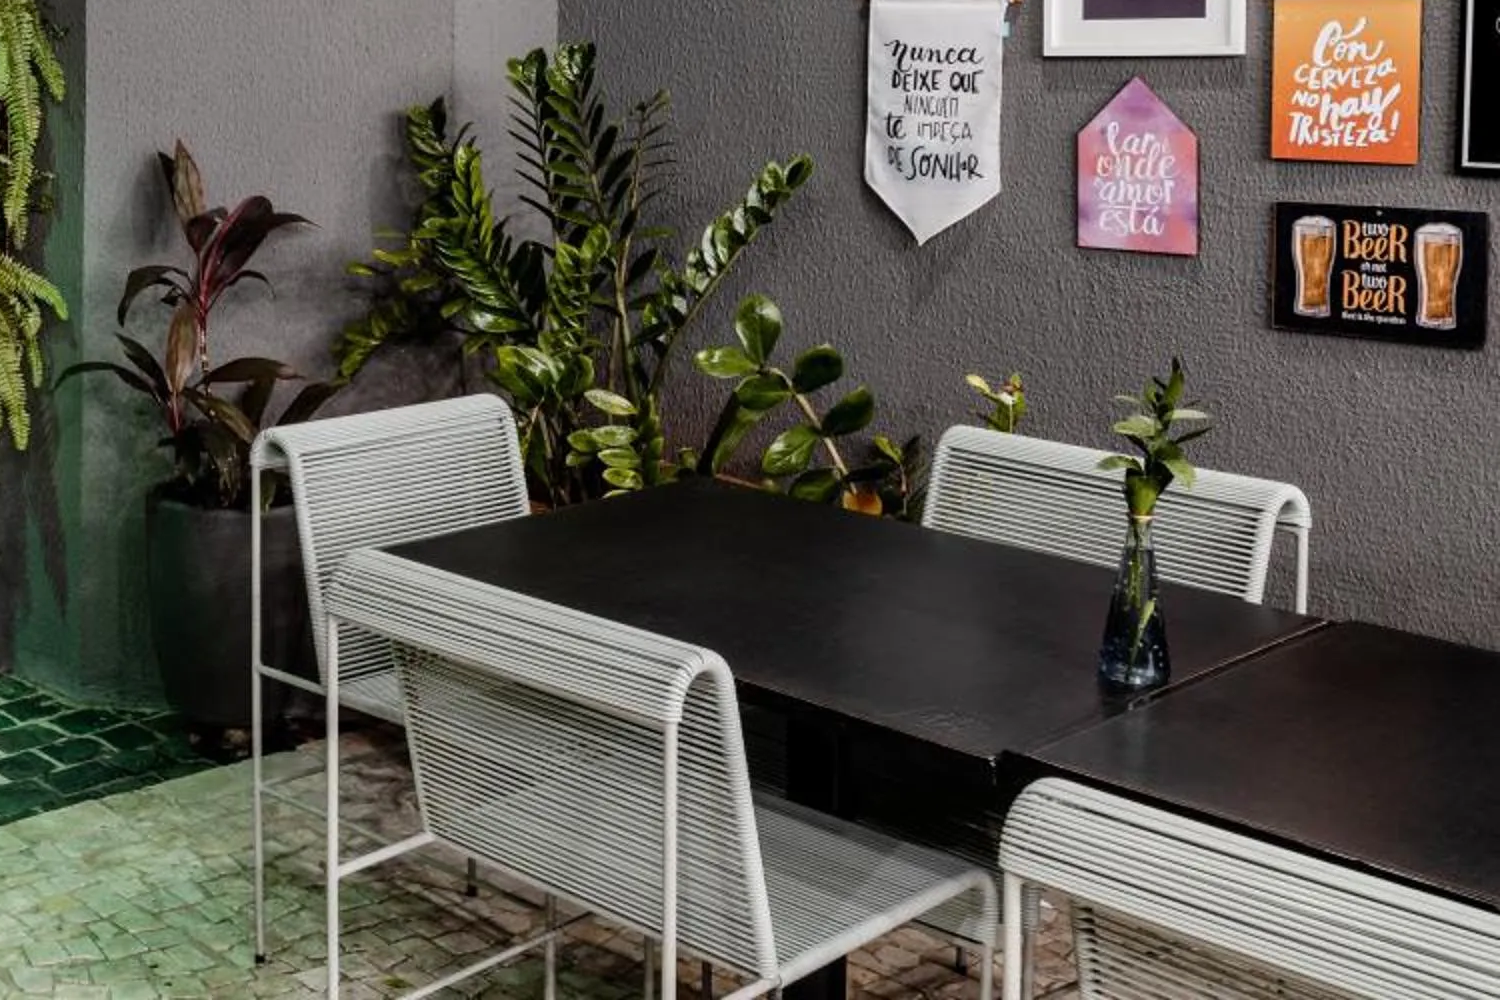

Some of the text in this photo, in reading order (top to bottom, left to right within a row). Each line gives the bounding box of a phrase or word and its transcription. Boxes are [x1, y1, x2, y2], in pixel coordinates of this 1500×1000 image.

[891, 69, 985, 94] DEIXE QUE
[1291, 82, 1401, 131] NO hay
[884, 111, 973, 145] te IMPEÇA
[1107, 121, 1156, 157] lar
[887, 146, 905, 173] DE
[1096, 142, 1180, 180] onde
[1099, 179, 1175, 205] amor
[1098, 199, 1165, 237] está
